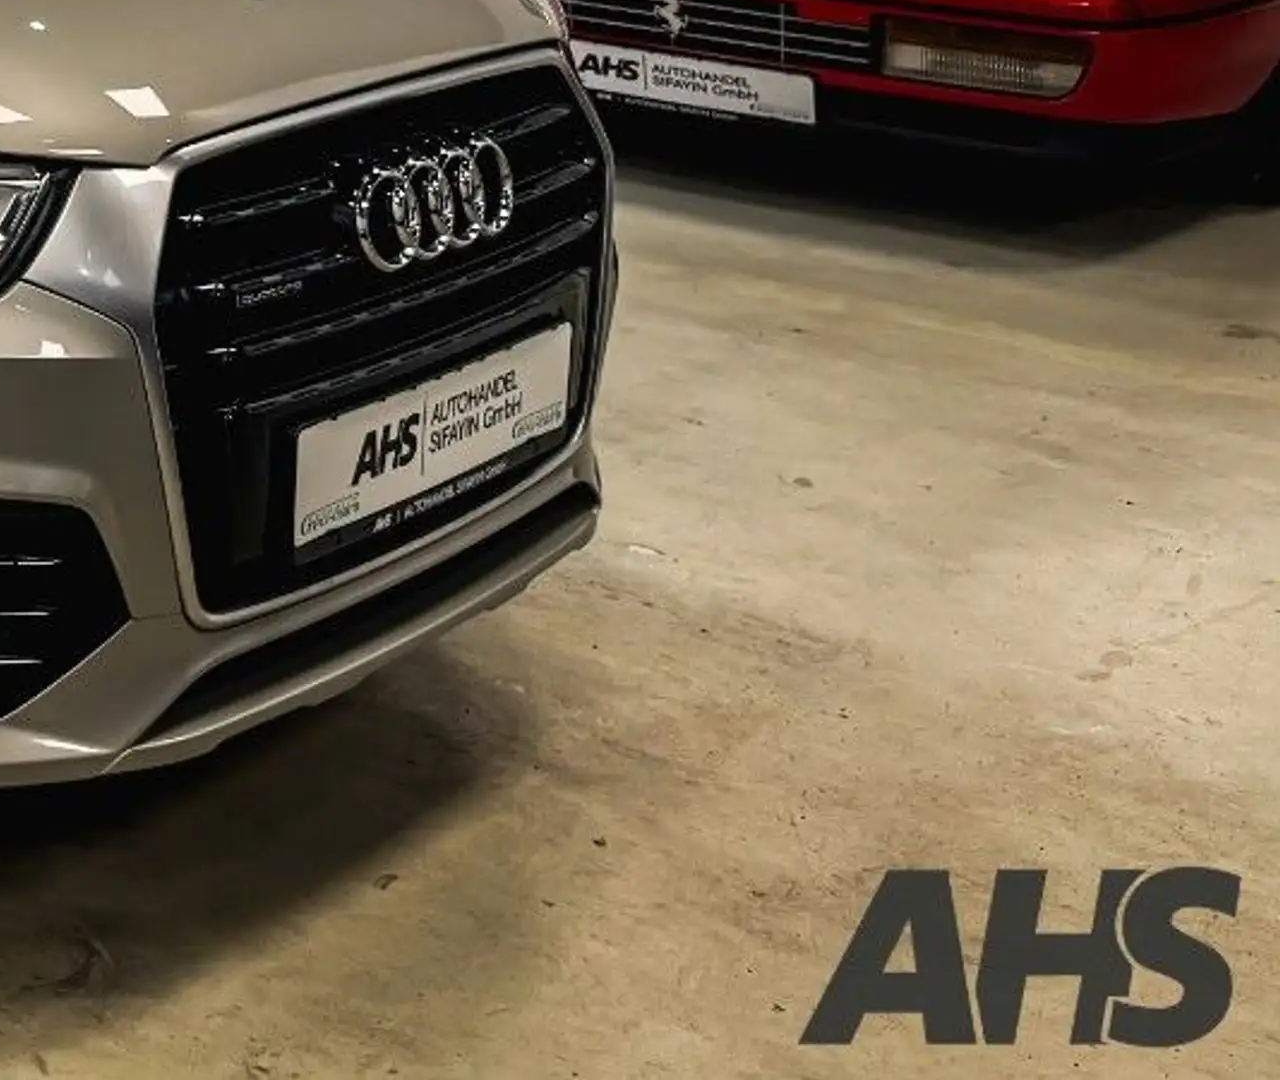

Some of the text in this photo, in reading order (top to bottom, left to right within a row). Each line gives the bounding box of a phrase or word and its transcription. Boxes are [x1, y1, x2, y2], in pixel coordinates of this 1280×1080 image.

[579, 52, 641, 82] AHS
[650, 63, 753, 91] AUTOHANDEL
[427, 413, 480, 453] SIFAYIN
[482, 391, 524, 430] GmbH
[432, 369, 519, 426] AUTOHANDEL
[350, 411, 420, 487] AHS
